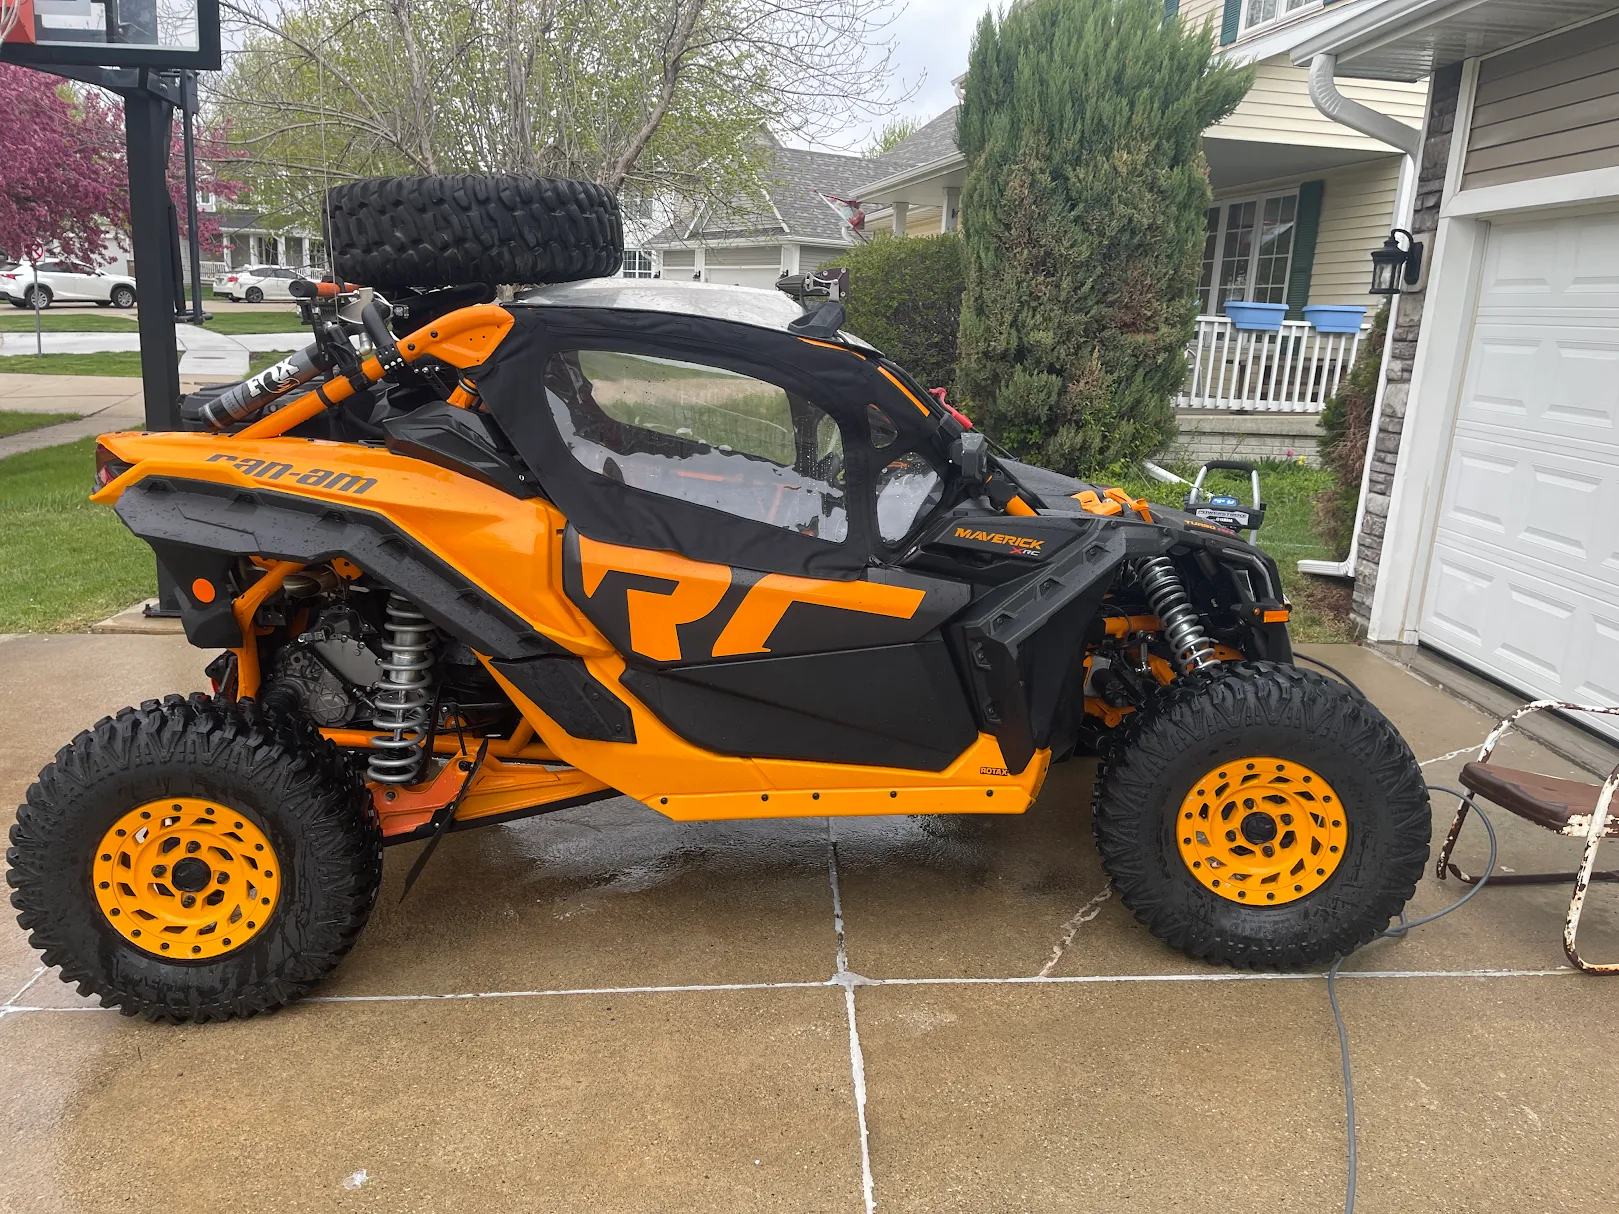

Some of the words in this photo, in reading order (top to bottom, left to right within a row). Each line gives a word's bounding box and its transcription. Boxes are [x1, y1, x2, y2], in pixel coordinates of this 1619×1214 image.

[245, 355, 300, 398] FOX
[1197, 510, 1248, 518] POWERSTROKE
[1184, 520, 1217, 530] TURBO
[954, 527, 1046, 550] MAVERICK
[1009, 546, 1041, 557] XRC
[980, 766, 1008, 776] ROTAX
